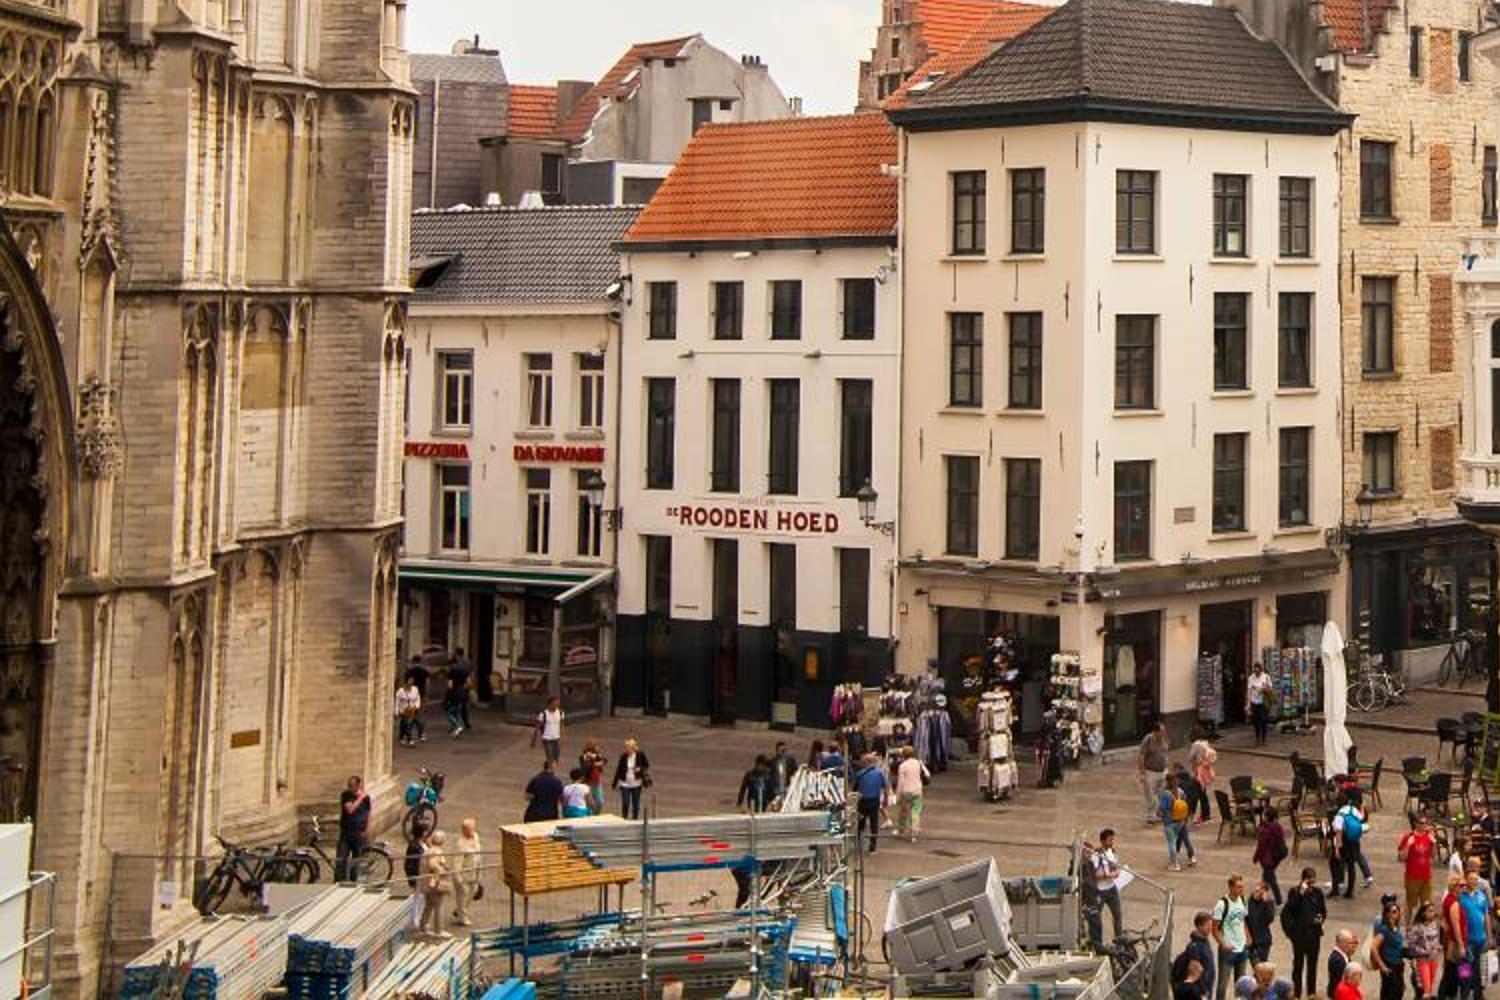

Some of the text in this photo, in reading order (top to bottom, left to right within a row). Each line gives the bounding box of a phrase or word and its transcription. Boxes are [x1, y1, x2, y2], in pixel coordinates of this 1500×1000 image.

[513, 445, 534, 461] DA
[680, 506, 768, 528] ROODEN
[777, 511, 839, 533] HOED
